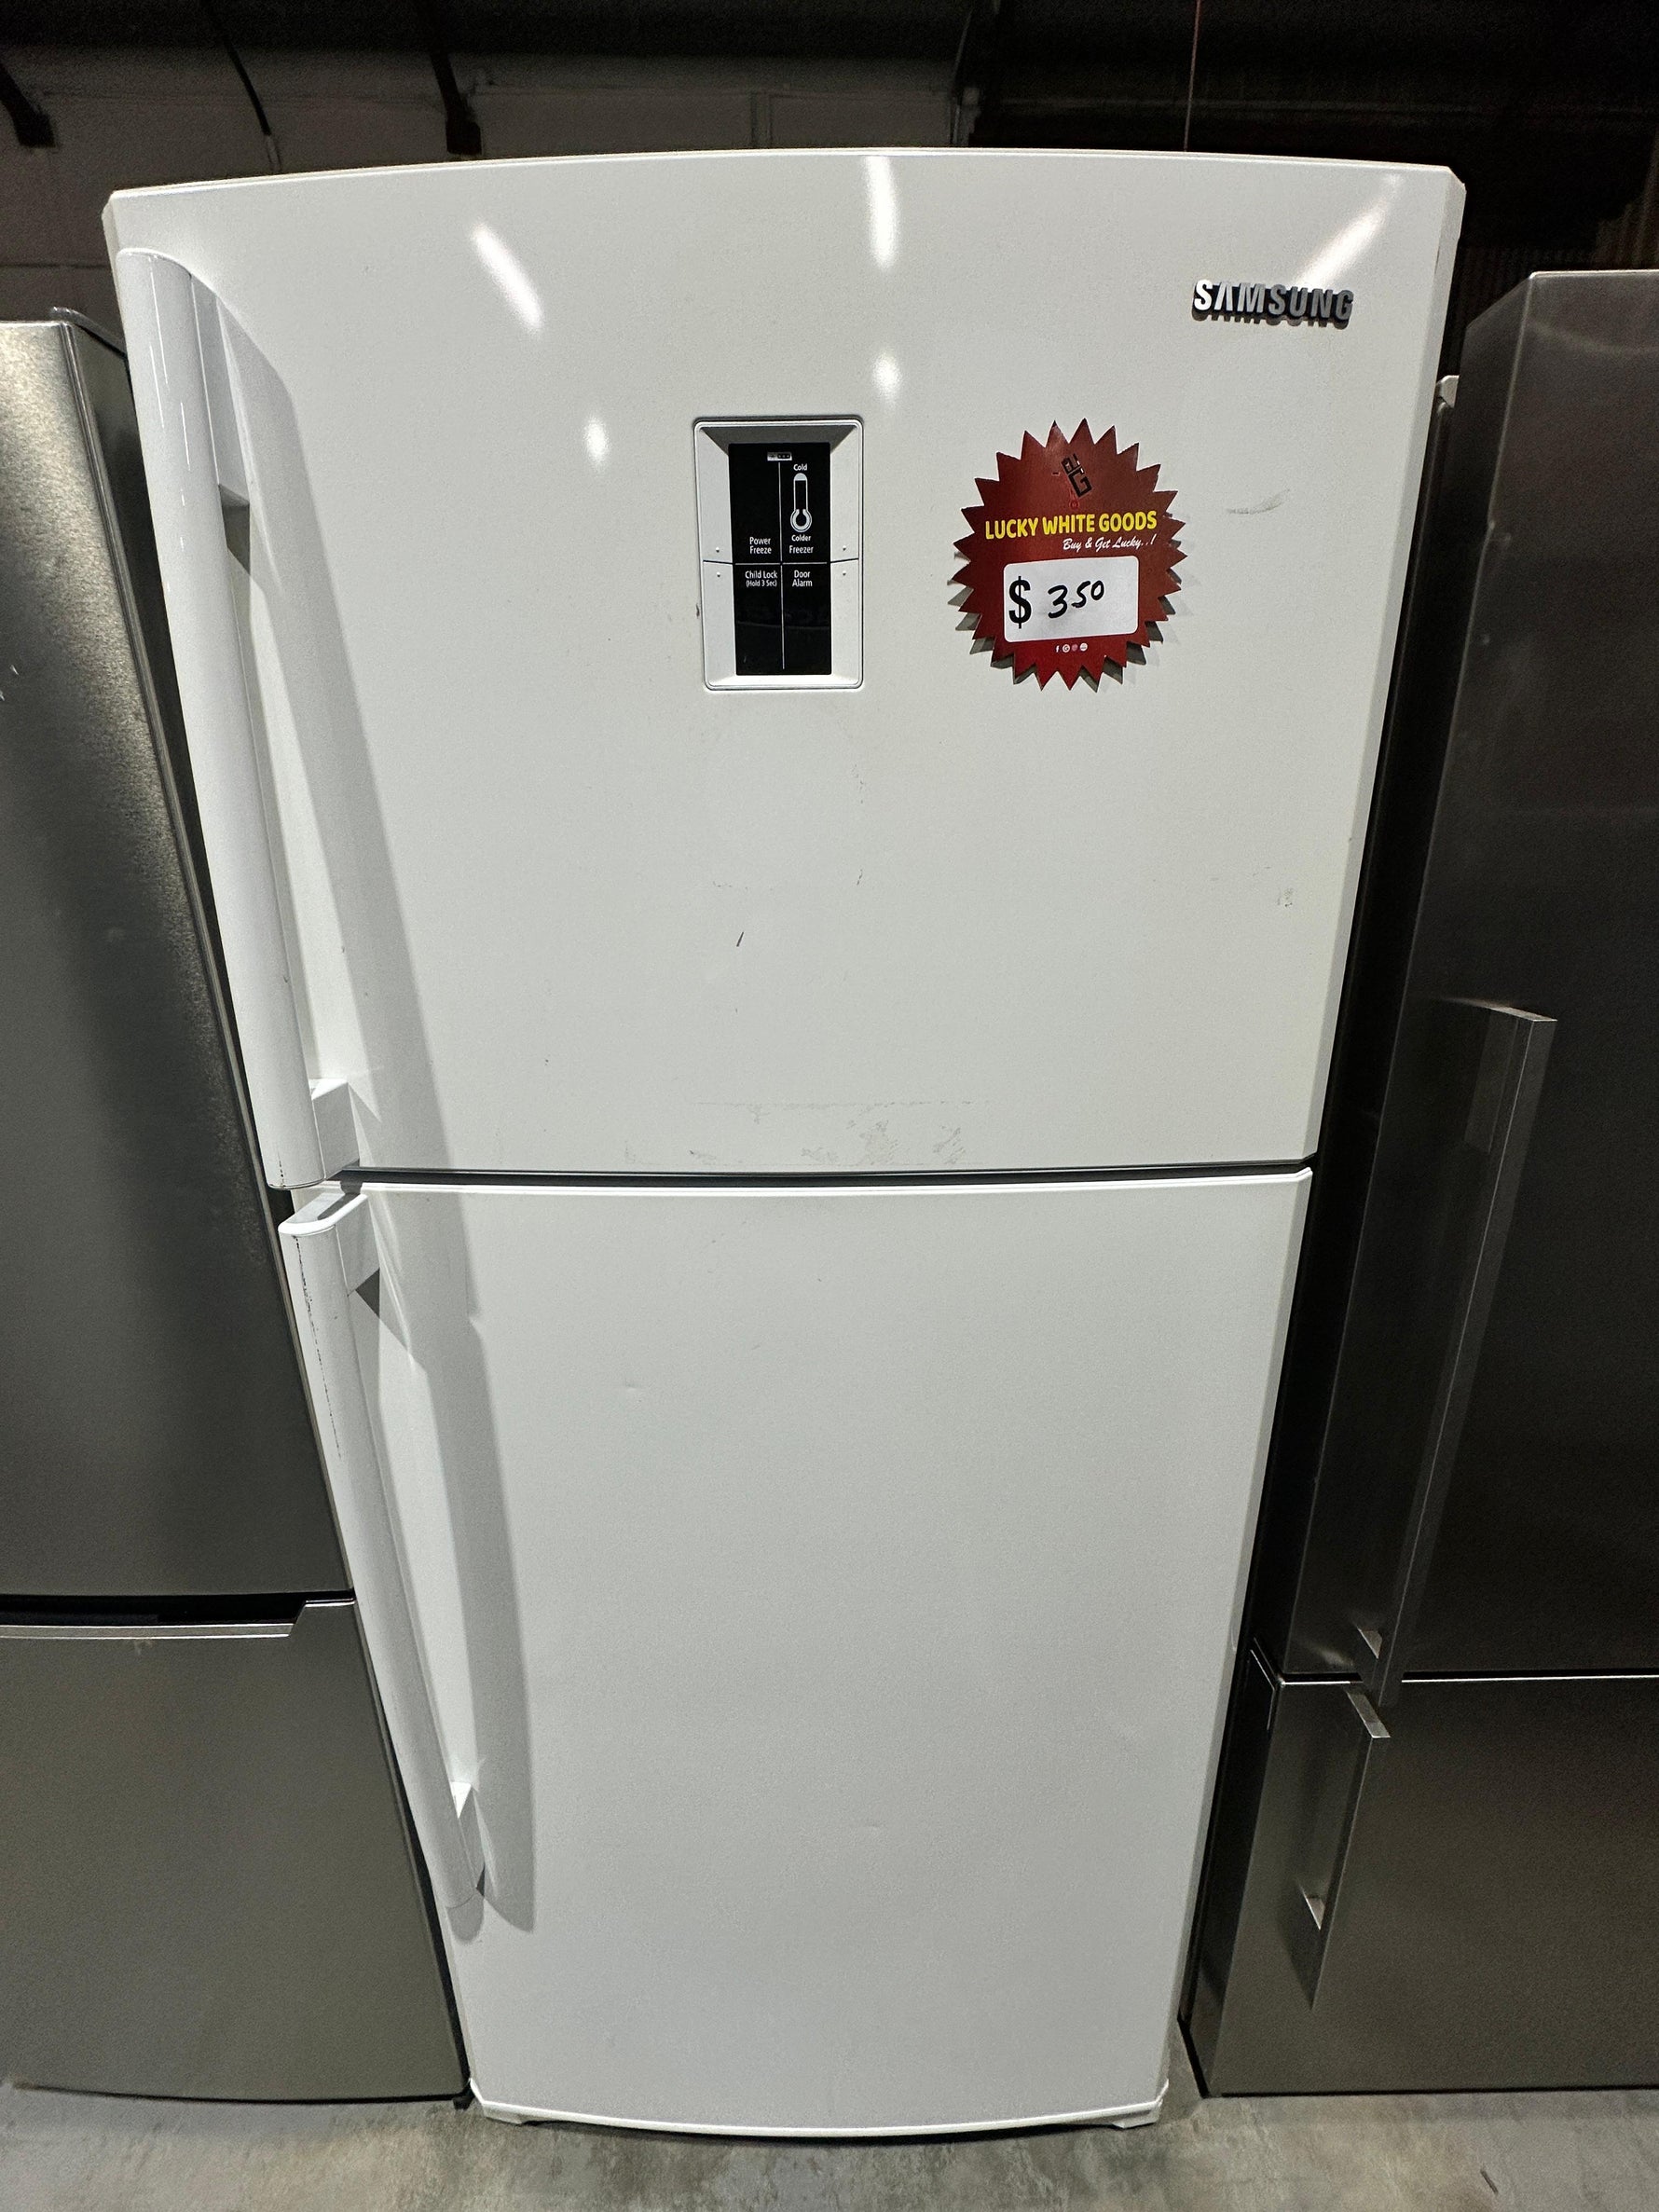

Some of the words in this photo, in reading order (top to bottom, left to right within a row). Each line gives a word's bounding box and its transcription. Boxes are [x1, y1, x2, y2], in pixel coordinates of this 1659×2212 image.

[1193, 279, 1354, 322] SAMSUNG
[793, 463, 808, 472] Cold
[985, 517, 1039, 540] LUCKY
[1042, 514, 1095, 535] WHITE
[1098, 510, 1158, 532] GOODS
[749, 536, 771, 545] Power
[1063, 538, 1081, 553] Buy
[1085, 538, 1092, 549] &
[1094, 537, 1111, 552] Get
[749, 545, 772, 555] Freeze
[788, 545, 814, 554] Freezer
[745, 570, 761, 579] Child
[762, 570, 778, 579] Lock
[794, 570, 811, 578] Door
[746, 579, 761, 588] (Hold
[766, 579, 777, 588] Sec)
[792, 578, 813, 587] Alarm
[1008, 576, 1032, 629] $
